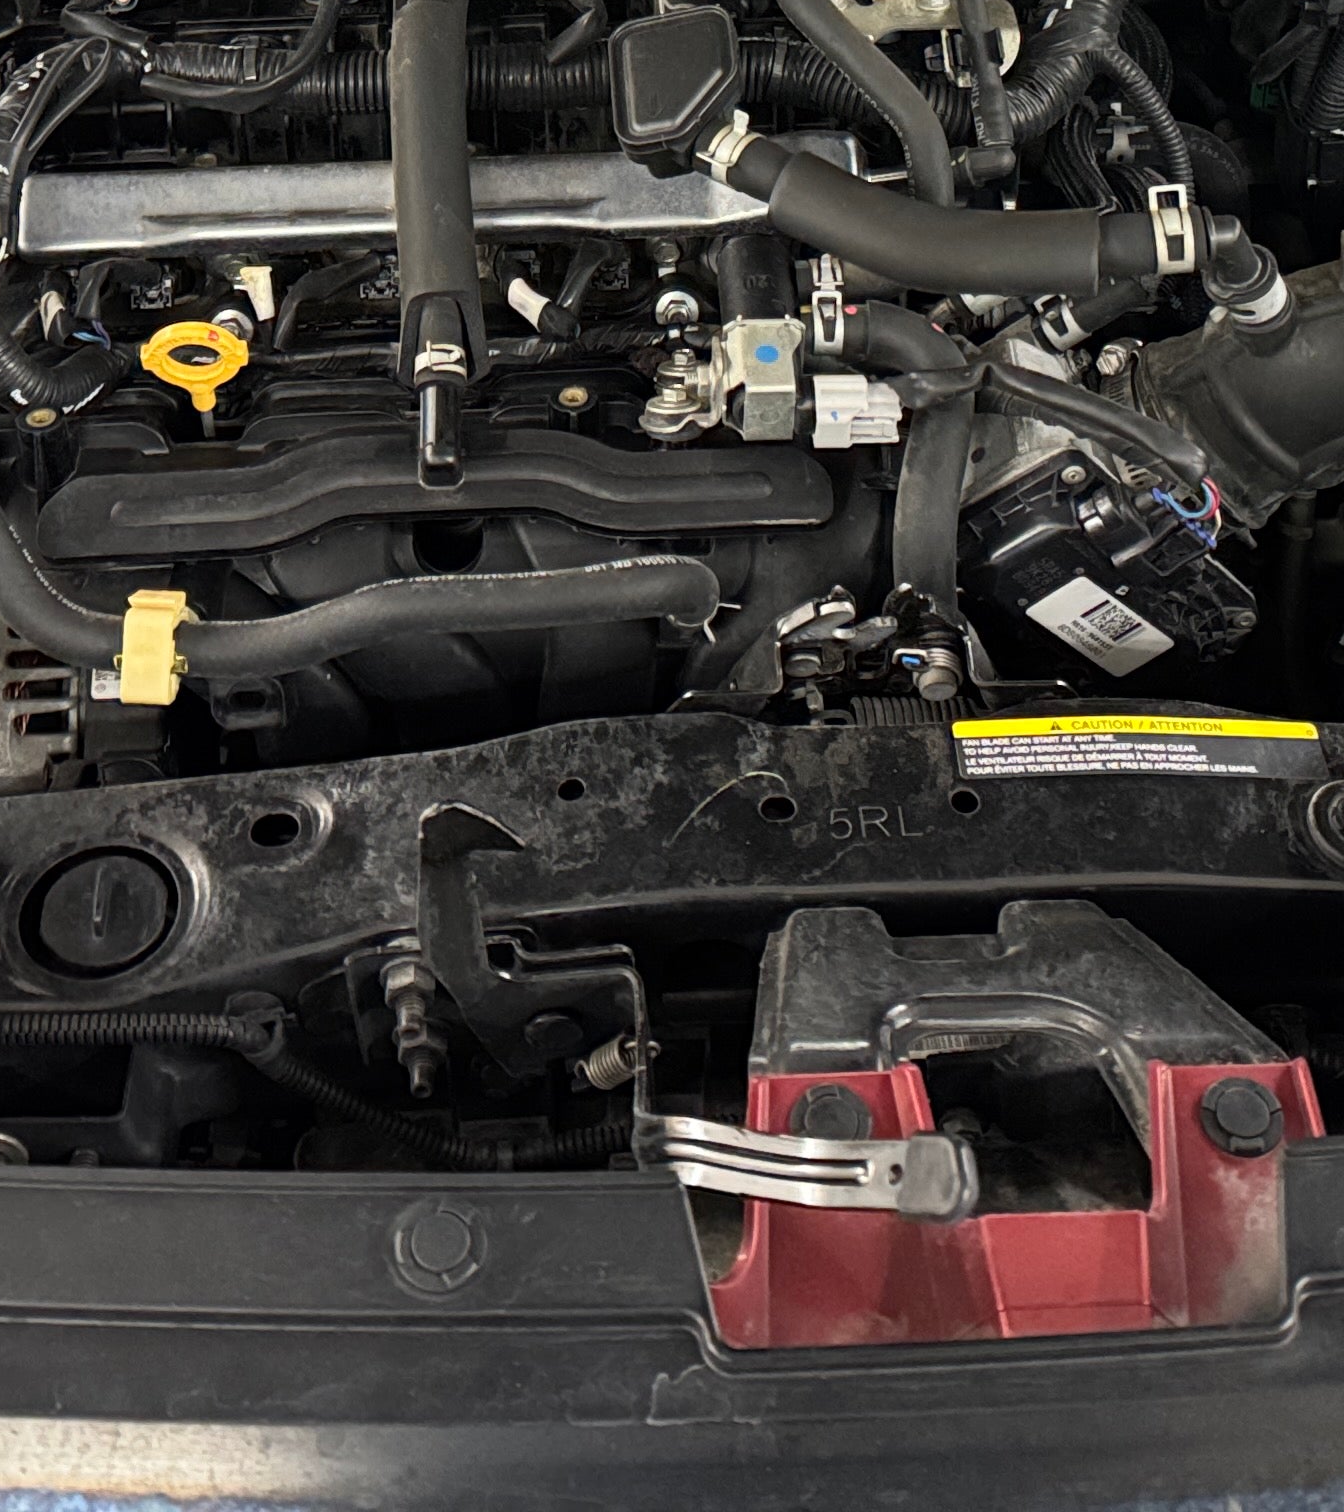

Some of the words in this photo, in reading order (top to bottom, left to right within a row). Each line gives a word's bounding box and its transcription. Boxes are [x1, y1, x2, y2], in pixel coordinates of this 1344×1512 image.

[1071, 719, 1133, 730] CAUTION
[1149, 720, 1223, 732] ATTENTION
[962, 739, 980, 747] FAN
[981, 738, 1010, 746] BLADE
[1011, 737, 1031, 745] CAN
[1032, 736, 1060, 744] START
[1095, 734, 1116, 742] TIME.
[963, 747, 976, 756] TO
[977, 747, 1001, 755] HELP
[1002, 746, 1030, 754] AVOID
[1031, 744, 1078, 753] PERSONAL
[1134, 743, 1166, 752] HANDS
[1167, 744, 1198, 752] CLEAR.
[965, 758, 976, 766] LE
[978, 756, 1035, 766] VENTILATEUR
[1036, 754, 1070, 763] RISQUE
[1071, 754, 1084, 762] DE
[1086, 752, 1135, 761] DÉMARRER
[1145, 753, 1167, 762] TOUT
[967, 766, 994, 775] POUR
[995, 764, 1025, 774] ÉVITER
[1027, 764, 1055, 772] TOUTE
[1057, 762, 1106, 771] BLESSURE,
[1106, 762, 1119, 770] NE
[1140, 762, 1153, 770] EN
[1154, 763, 1209, 772] APPROCHER
[1210, 764, 1227, 772] LES
[829, 805, 924, 840] 5RL
